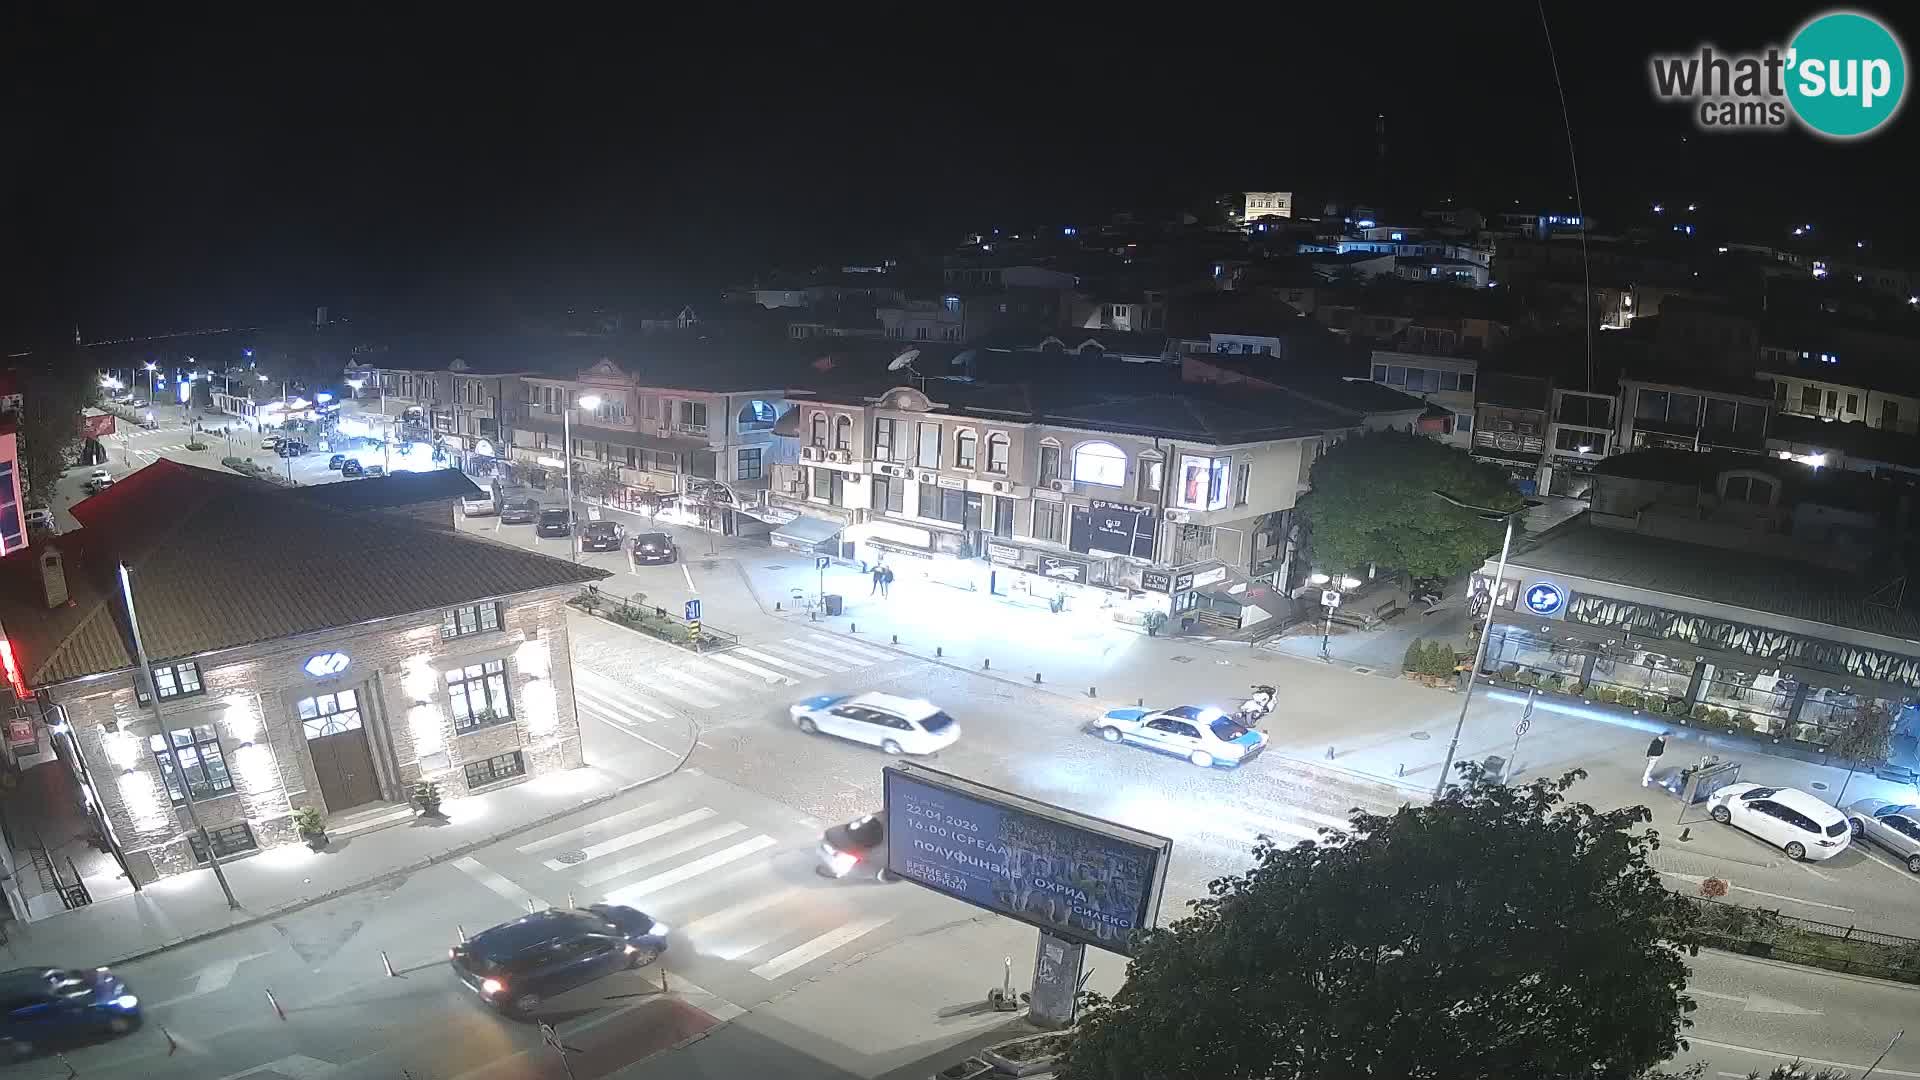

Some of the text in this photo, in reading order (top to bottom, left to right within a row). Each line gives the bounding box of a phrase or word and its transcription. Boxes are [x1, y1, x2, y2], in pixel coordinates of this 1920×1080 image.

[906, 803, 979, 832] 22.04.2026
[908, 818, 947, 837] 16:00
[1034, 878, 1087, 903] ОХРИД
[1073, 905, 1129, 927] СИЛЕКС
